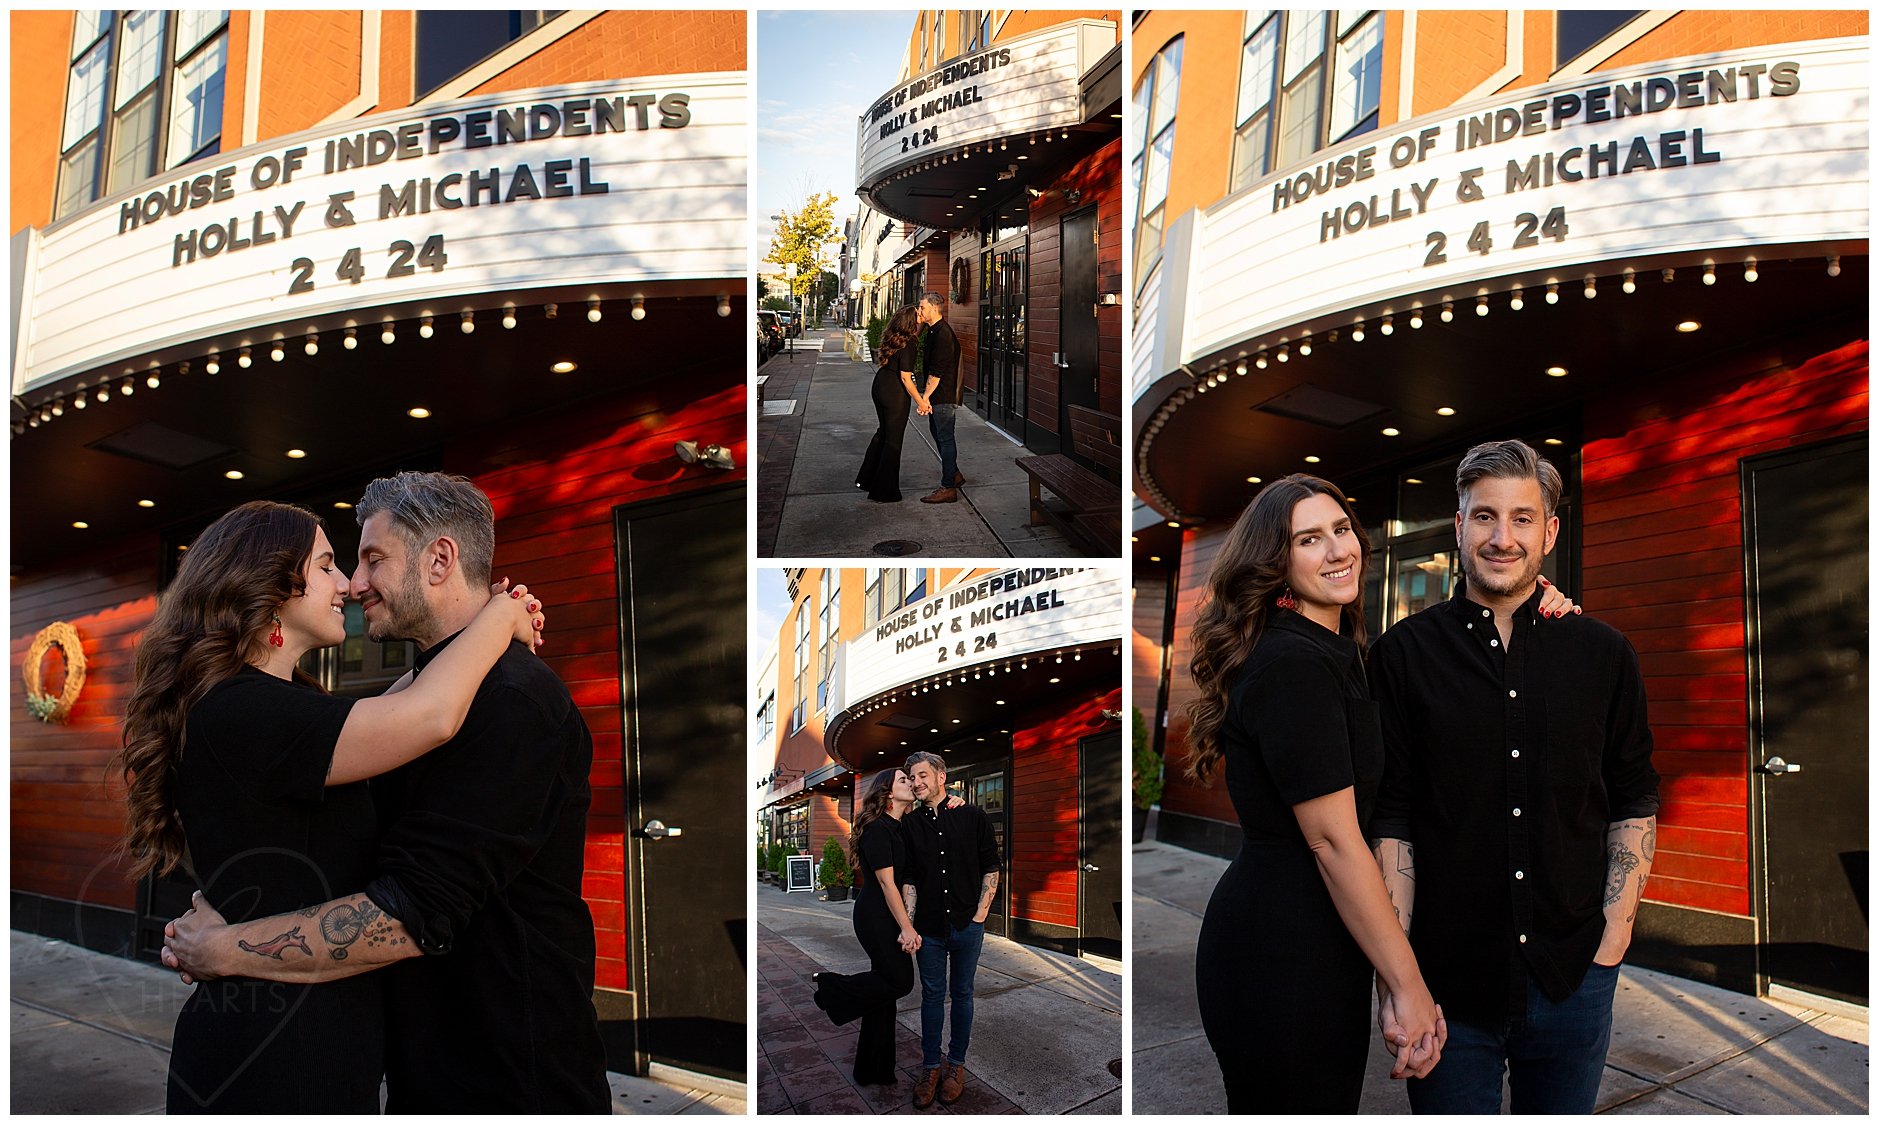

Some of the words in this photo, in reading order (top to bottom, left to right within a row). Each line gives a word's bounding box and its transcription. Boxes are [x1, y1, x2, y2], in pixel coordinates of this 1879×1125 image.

[871, 95, 893, 124] HOUSE
[895, 88, 908, 108] OF
[909, 48, 1011, 100] INDEPENDENTS
[880, 112, 906, 140] HOLLY
[921, 85, 982, 120] MICHAEL
[119, 166, 236, 235] HOUSE
[252, 147, 307, 191] OF
[325, 93, 691, 175] INDEPENDENTS
[901, 137, 909, 153] 2
[912, 132, 919, 148] 4
[923, 125, 938, 145] 24
[1272, 146, 1376, 214] HOUSE
[1390, 127, 1441, 171] OF
[1456, 61, 1800, 153] INDEPENDENTS
[173, 201, 305, 267] HOLLY
[324, 191, 355, 229] &
[380, 157, 609, 220] MICHAEL
[1320, 177, 1439, 242] HOLLY
[1457, 168, 1484, 203] &
[1507, 128, 1721, 195] MICHAEL
[289, 257, 314, 295] 2
[337, 247, 364, 285] 4
[387, 234, 447, 279] 24
[1424, 232, 1447, 267] 2
[1467, 221, 1493, 257] 4
[1514, 206, 1569, 251] 24
[876, 609, 917, 642] HOUSE
[923, 598, 944, 620] OF
[896, 622, 943, 654] HOLLY
[950, 616, 962, 633] &
[971, 589, 1064, 628] MICHAEL
[938, 647, 947, 663] 2
[955, 641, 966, 657] 4
[974, 632, 997, 653] 24
